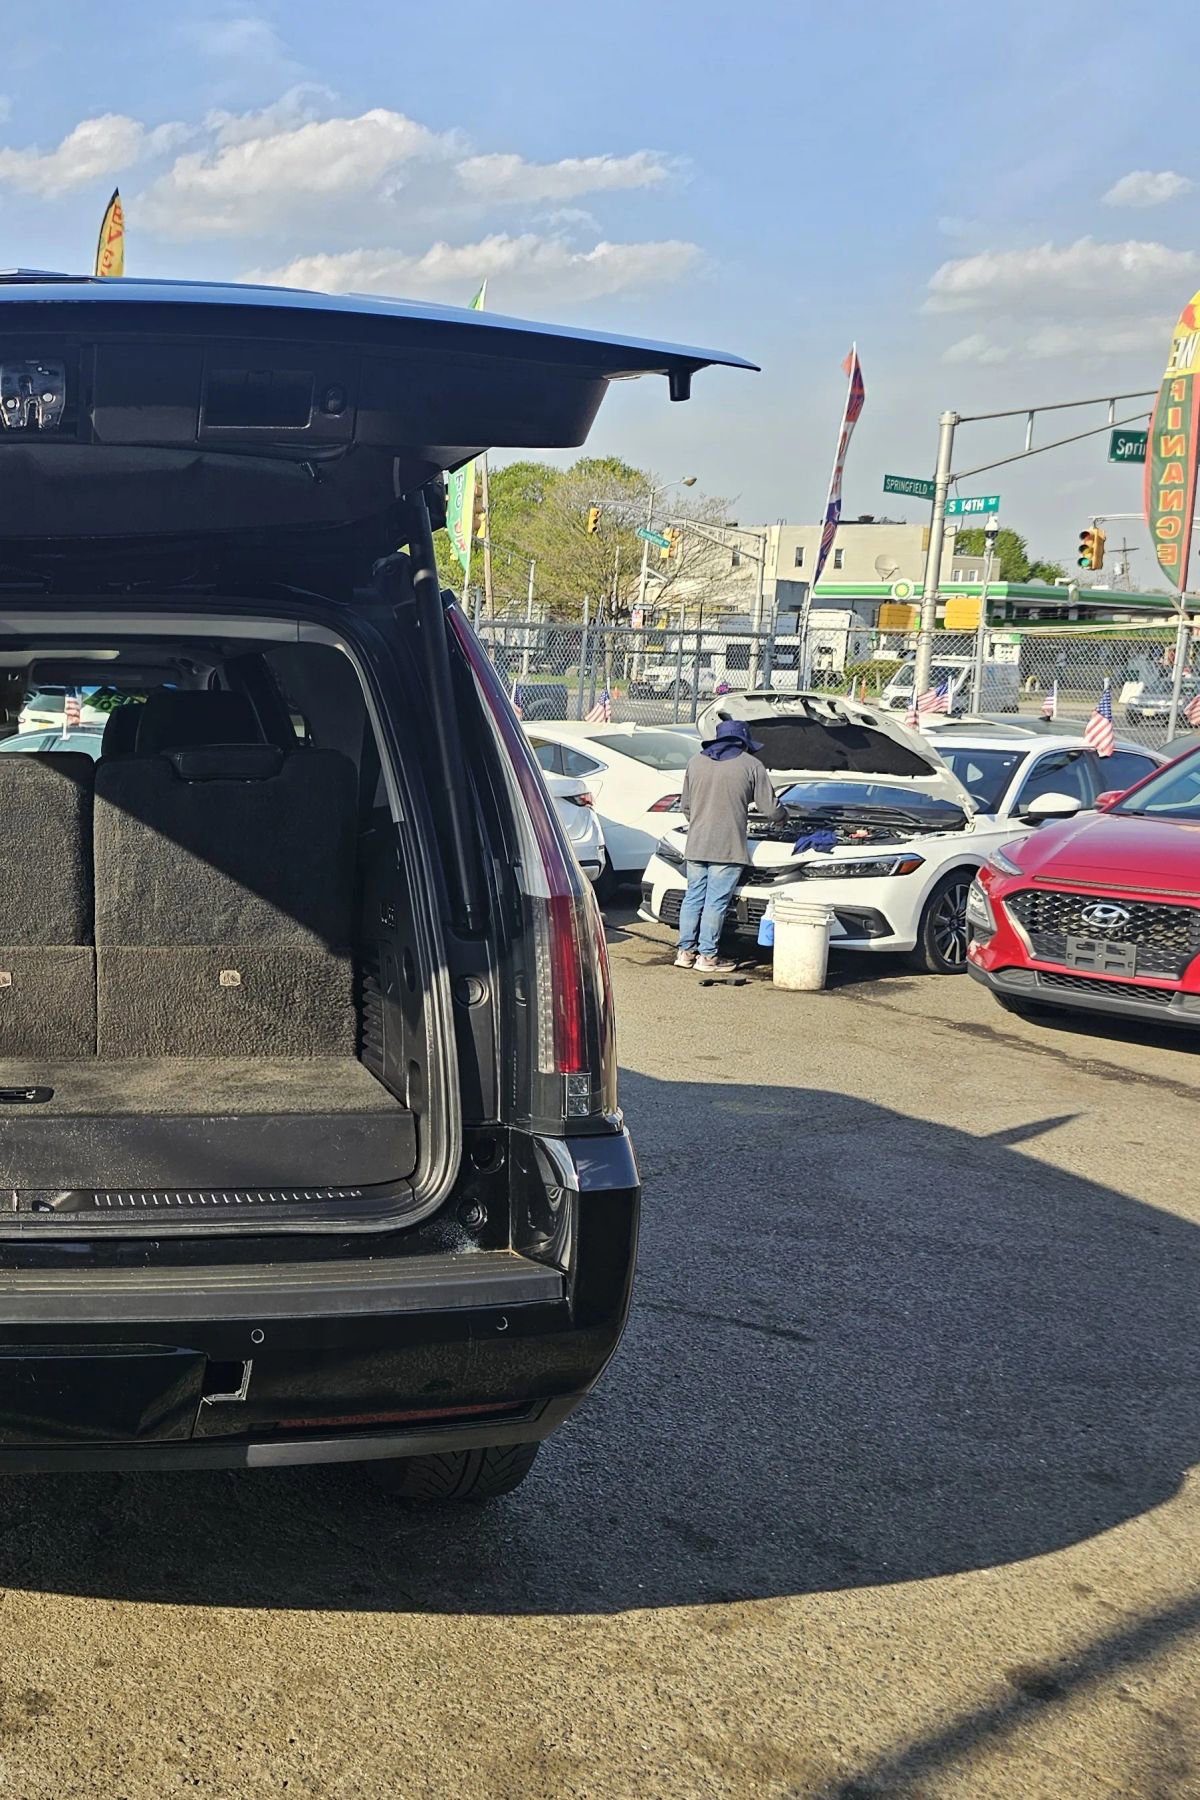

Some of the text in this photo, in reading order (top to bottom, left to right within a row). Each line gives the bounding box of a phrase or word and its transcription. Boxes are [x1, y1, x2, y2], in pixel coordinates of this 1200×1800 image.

[1116, 438, 1146, 458] Spri
[886, 478, 928, 495] SPRINGFIELD
[949, 497, 997, 512] S 14TH ST
